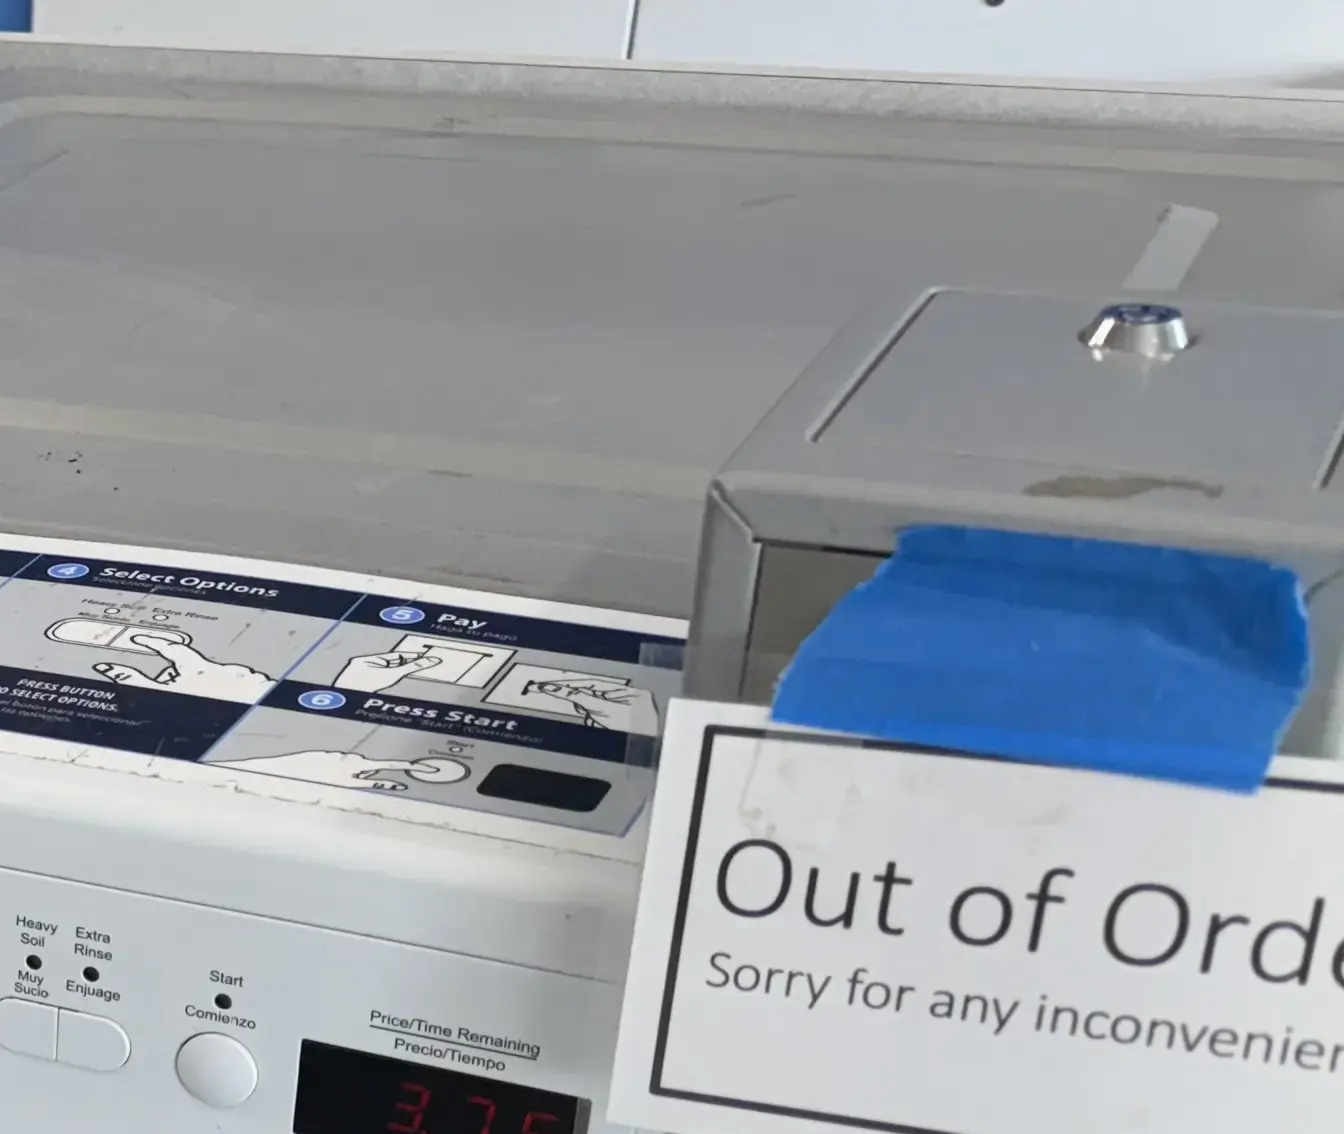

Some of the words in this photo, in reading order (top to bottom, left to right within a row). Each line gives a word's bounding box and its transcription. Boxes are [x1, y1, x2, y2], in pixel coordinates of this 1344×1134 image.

[100, 565, 175, 584] Select
[178, 575, 279, 599] Options
[437, 613, 486, 630] Pay
[10, 687, 56, 702] SELECT
[57, 695, 120, 712] OPTIONS.
[17, 677, 59, 691] PRESS
[59, 684, 114, 700] BUTTON
[363, 697, 438, 719] Press
[445, 709, 518, 731] Start
[715, 838, 914, 937] Out
[948, 866, 1076, 955] of
[1102, 883, 1344, 990] Ord
[16, 915, 59, 936] Heavy
[75, 926, 111, 944] Extra
[20, 933, 45, 948] Soil
[74, 943, 113, 961] Rinse
[17, 970, 45, 986] Muy
[209, 970, 244, 988] Start
[14, 981, 50, 999] Sucio
[65, 980, 121, 1002] Enjuage
[705, 951, 831, 1010] Sorry
[846, 968, 916, 1013] for
[929, 982, 1021, 1034] any
[184, 1005, 257, 1030] Comienzo
[369, 1009, 453, 1038] Price/Time
[457, 1028, 541, 1058] Remaining
[394, 1037, 506, 1072] Precio/Tiempo
